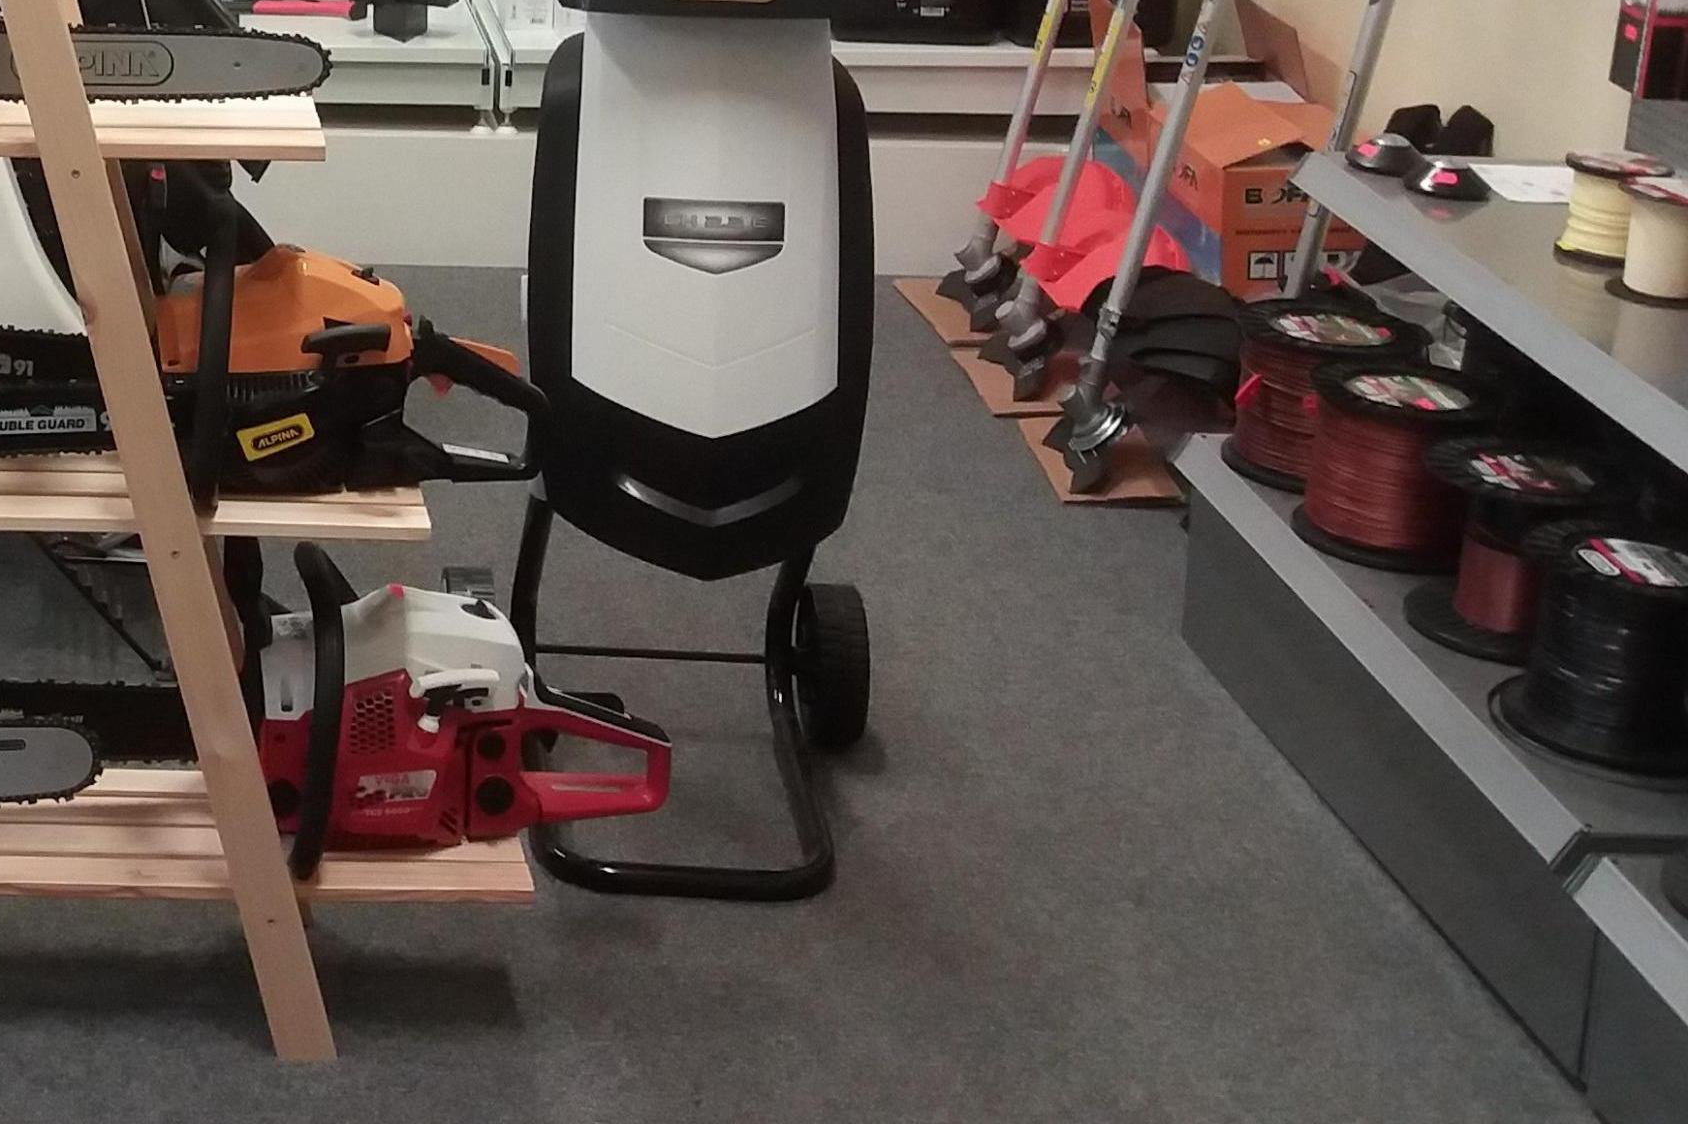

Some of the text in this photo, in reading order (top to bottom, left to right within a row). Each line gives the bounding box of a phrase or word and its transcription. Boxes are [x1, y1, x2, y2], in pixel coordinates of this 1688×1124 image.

[76, 50, 160, 78] PINA
[13, 360, 34, 376] 91
[37, 418, 85, 431] GUARD
[257, 427, 300, 450] ALPINA
